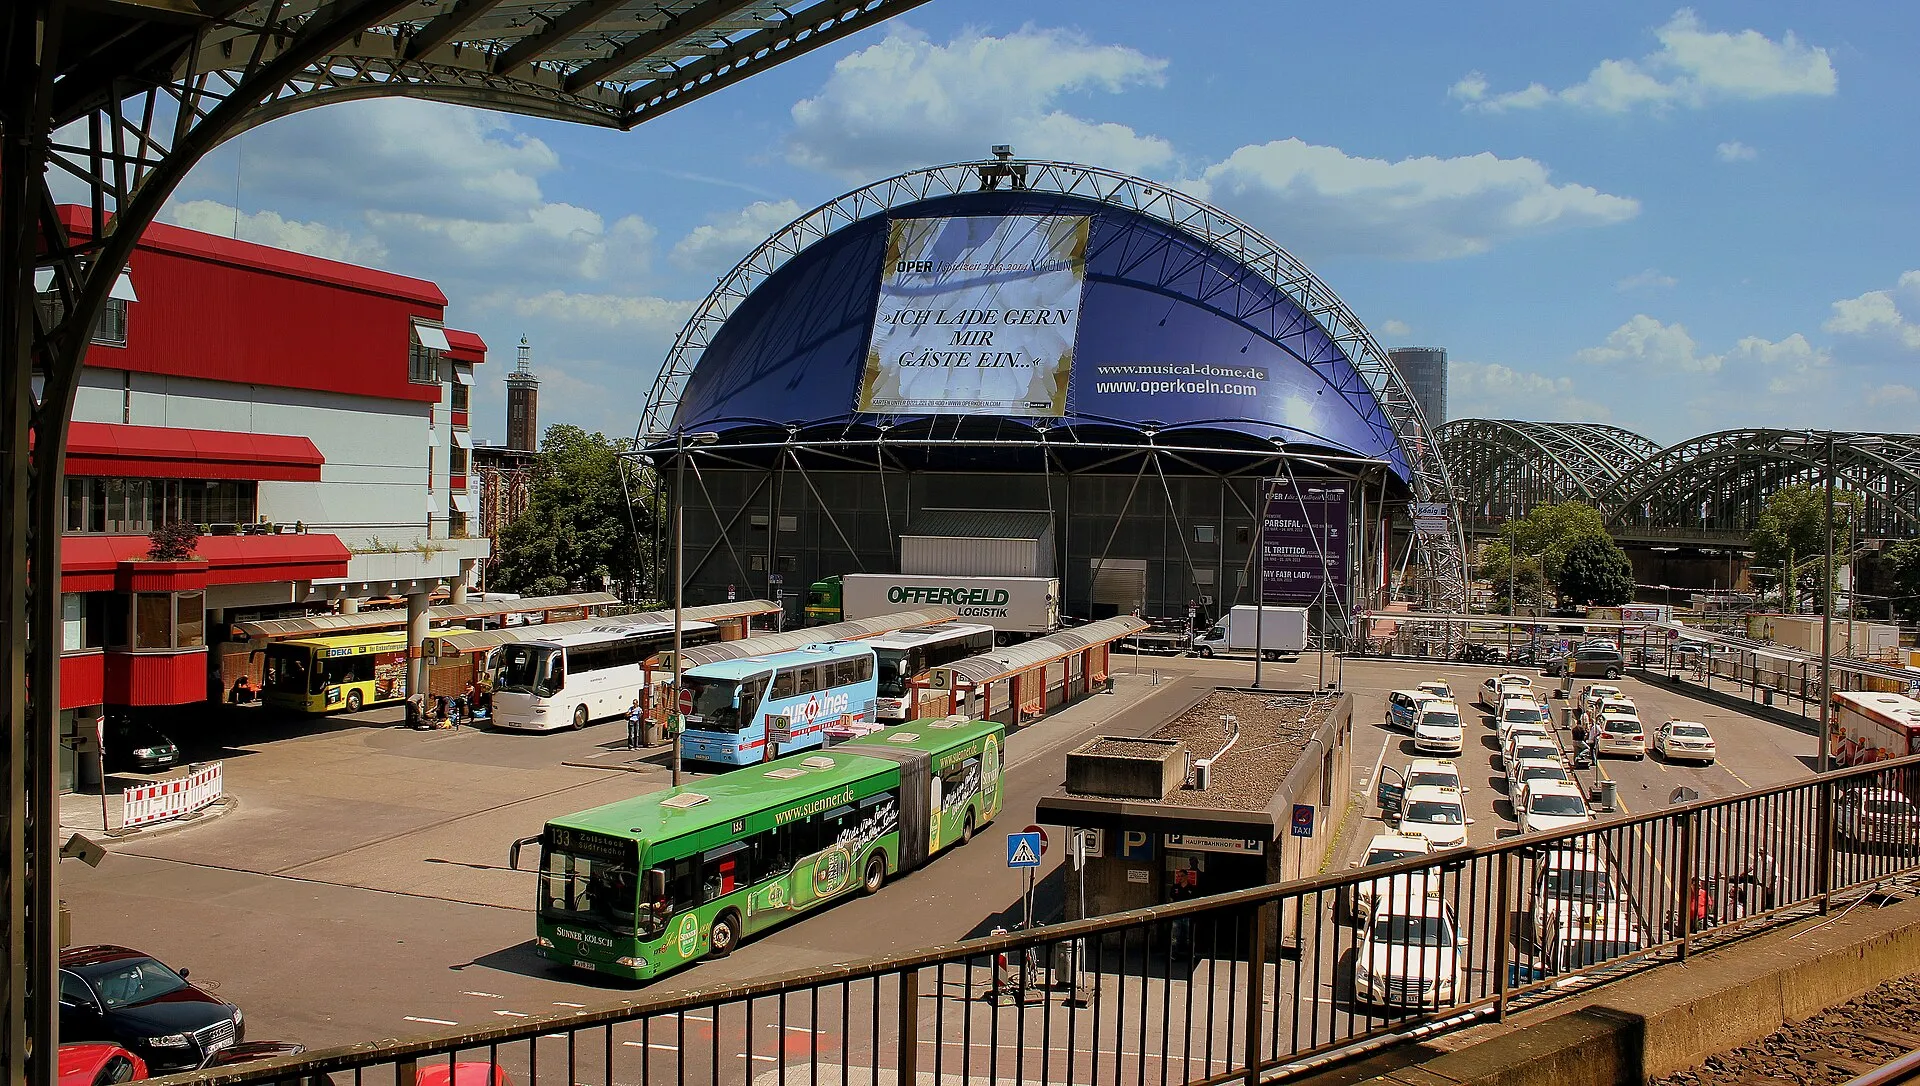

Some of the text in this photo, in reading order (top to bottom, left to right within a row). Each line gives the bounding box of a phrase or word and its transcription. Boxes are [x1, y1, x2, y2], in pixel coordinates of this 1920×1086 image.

[897, 260, 933, 273] OPER
[1039, 258, 1073, 272] KÖLN
[882, 309, 1073, 325] »ICH LADE GERN
[948, 330, 994, 346] MIR
[898, 348, 972, 368] GÄSTE
[1097, 363, 1264, 380] www.musical-dome.de
[1096, 378, 1258, 396] www.operkoeln.com
[1264, 519, 1301, 528] PARSIFAL
[1264, 546, 1272, 554] IL
[1273, 546, 1305, 554] TRITTICO
[887, 586, 1009, 605] OFFERGELD
[958, 607, 1008, 617] LOGISTIK
[326, 648, 353, 657] EDEKA
[428, 640, 435, 654] 3
[662, 655, 672, 669] 4
[935, 671, 945, 687] 5
[775, 785, 854, 824] www.suenner.de
[1293, 825, 1311, 835] TAXI
[552, 828, 624, 848] 133 Zollstock
[1123, 831, 1147, 857] P
[1172, 834, 1180, 842] P
[1248, 839, 1256, 848] P
[578, 842, 626, 857] Südfriedhof
